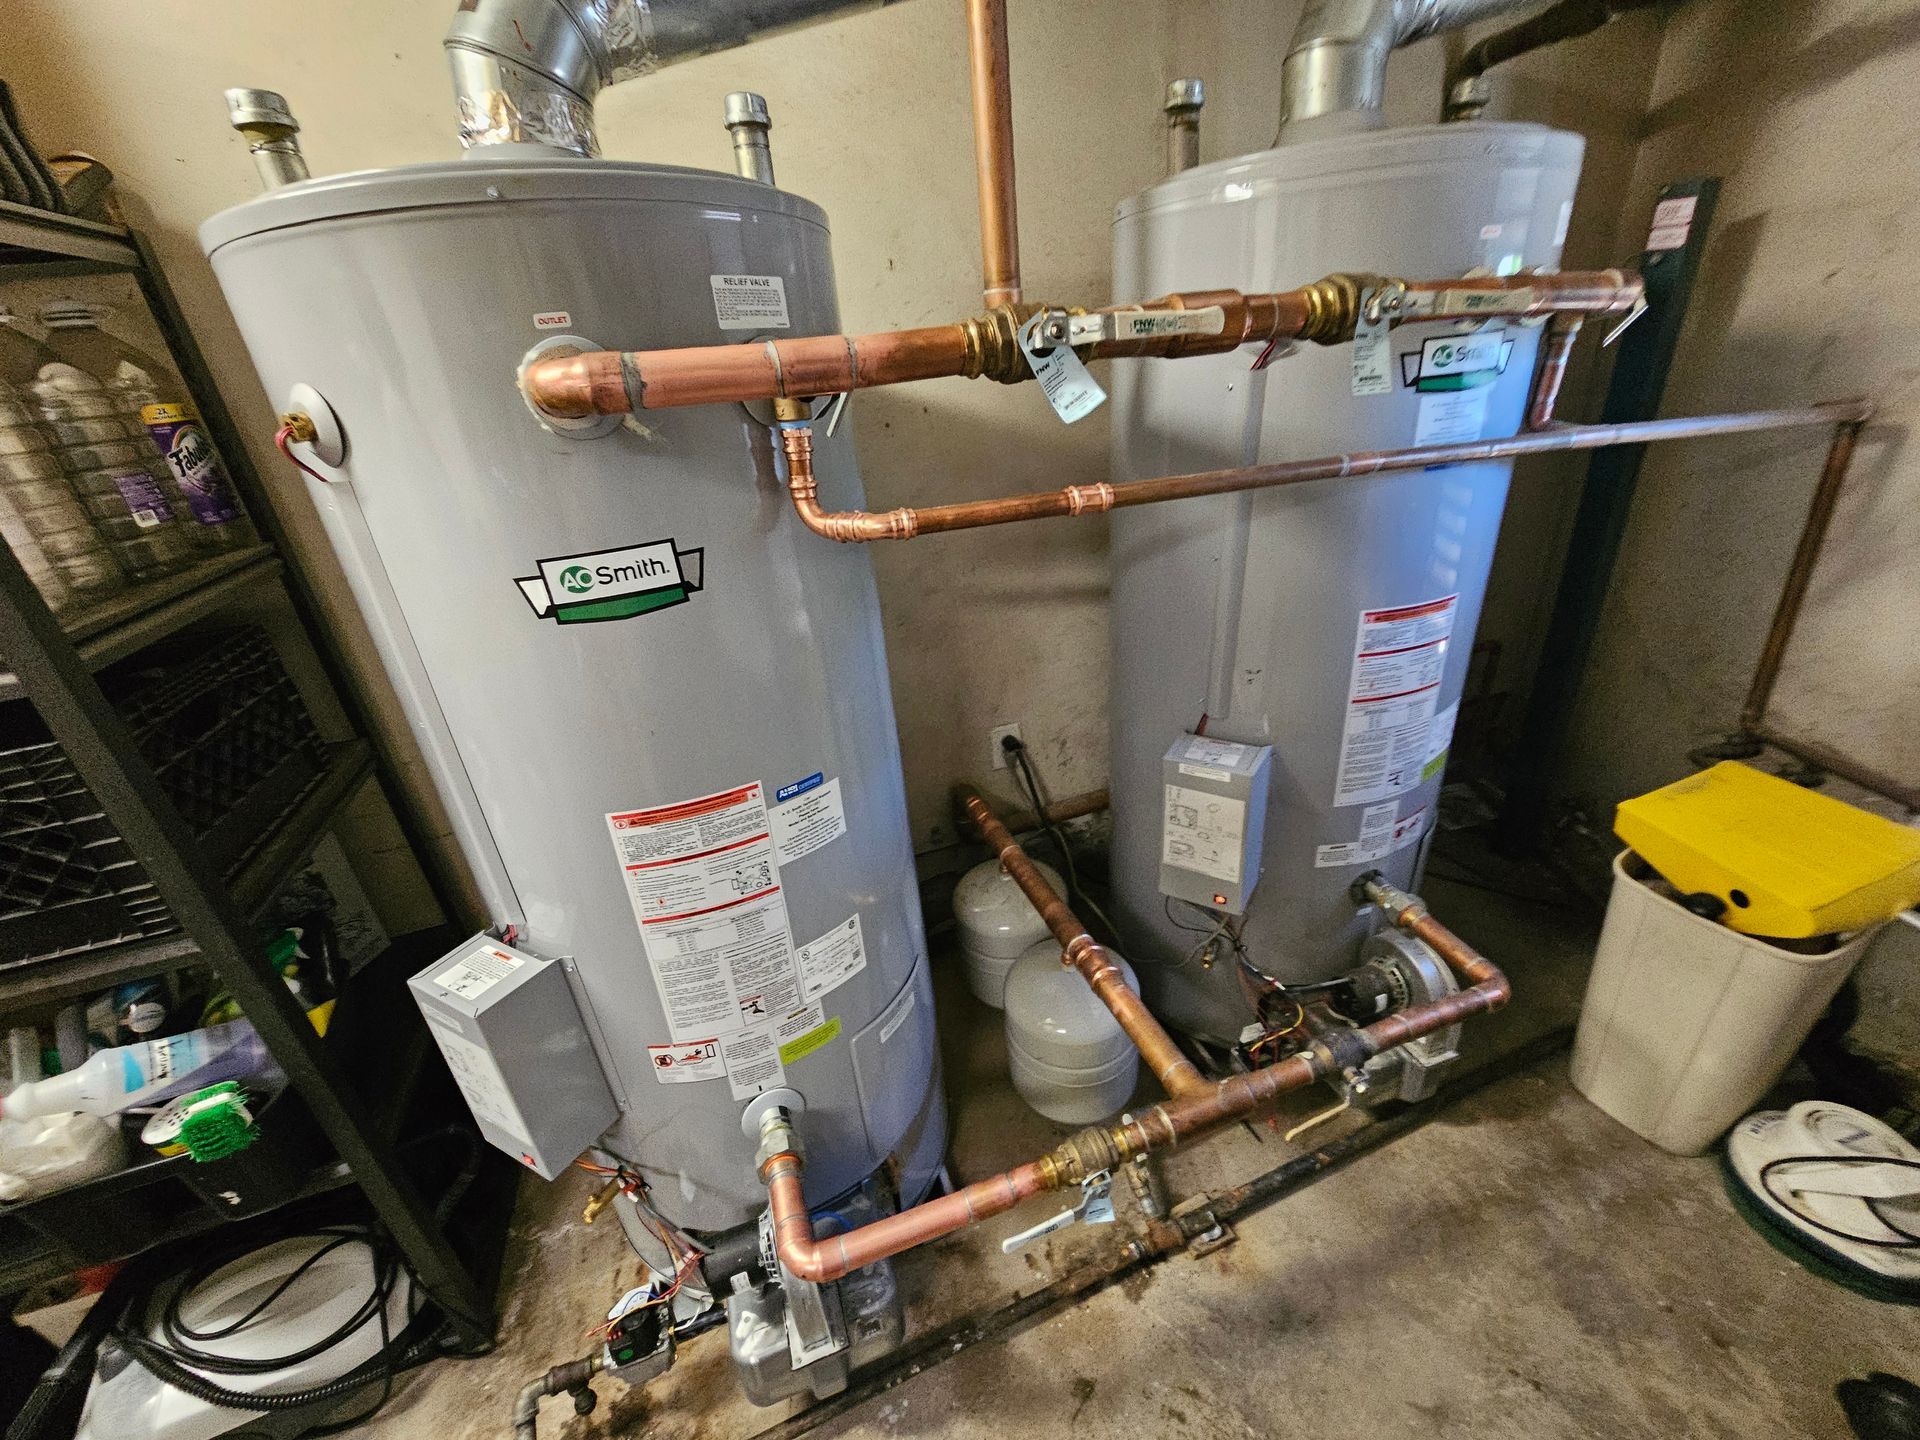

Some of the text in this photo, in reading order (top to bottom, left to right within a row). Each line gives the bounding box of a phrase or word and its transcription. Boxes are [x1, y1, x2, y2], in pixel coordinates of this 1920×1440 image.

[723, 277, 770, 287] RELIEF VALVE
[538, 316, 567, 325] OUTLET
